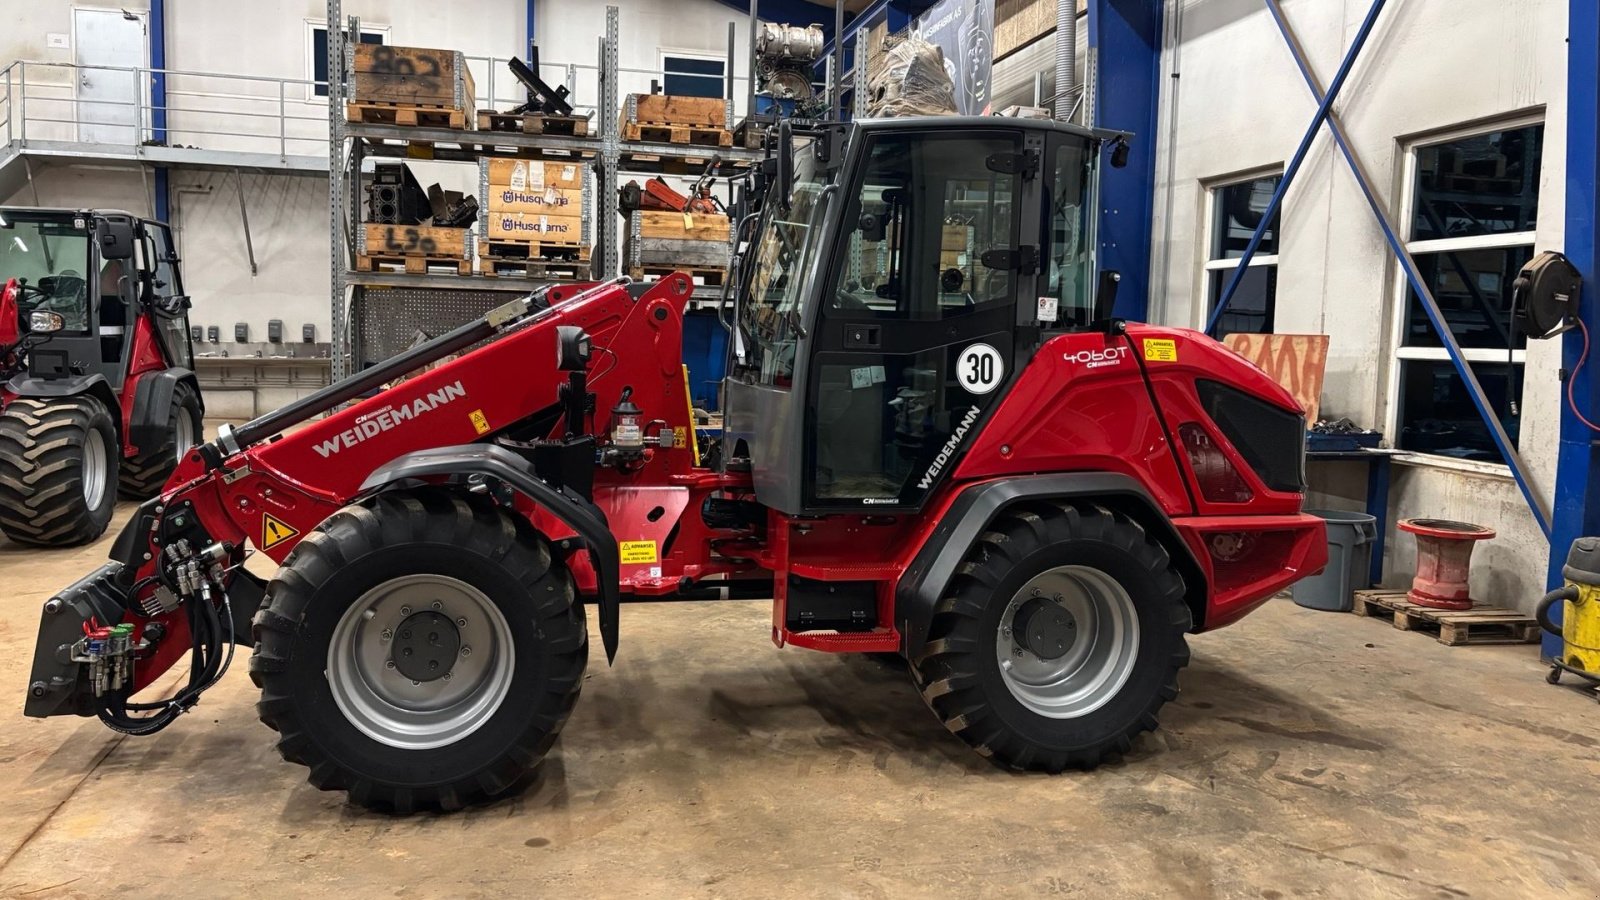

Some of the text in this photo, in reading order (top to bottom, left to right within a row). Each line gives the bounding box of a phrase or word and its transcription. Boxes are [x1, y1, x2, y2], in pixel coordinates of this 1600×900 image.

[514, 221, 568, 233] Husqarna
[966, 353, 994, 385] 30
[312, 380, 467, 459] WEIDEMANN
[917, 405, 981, 490] WEIDEMANN
